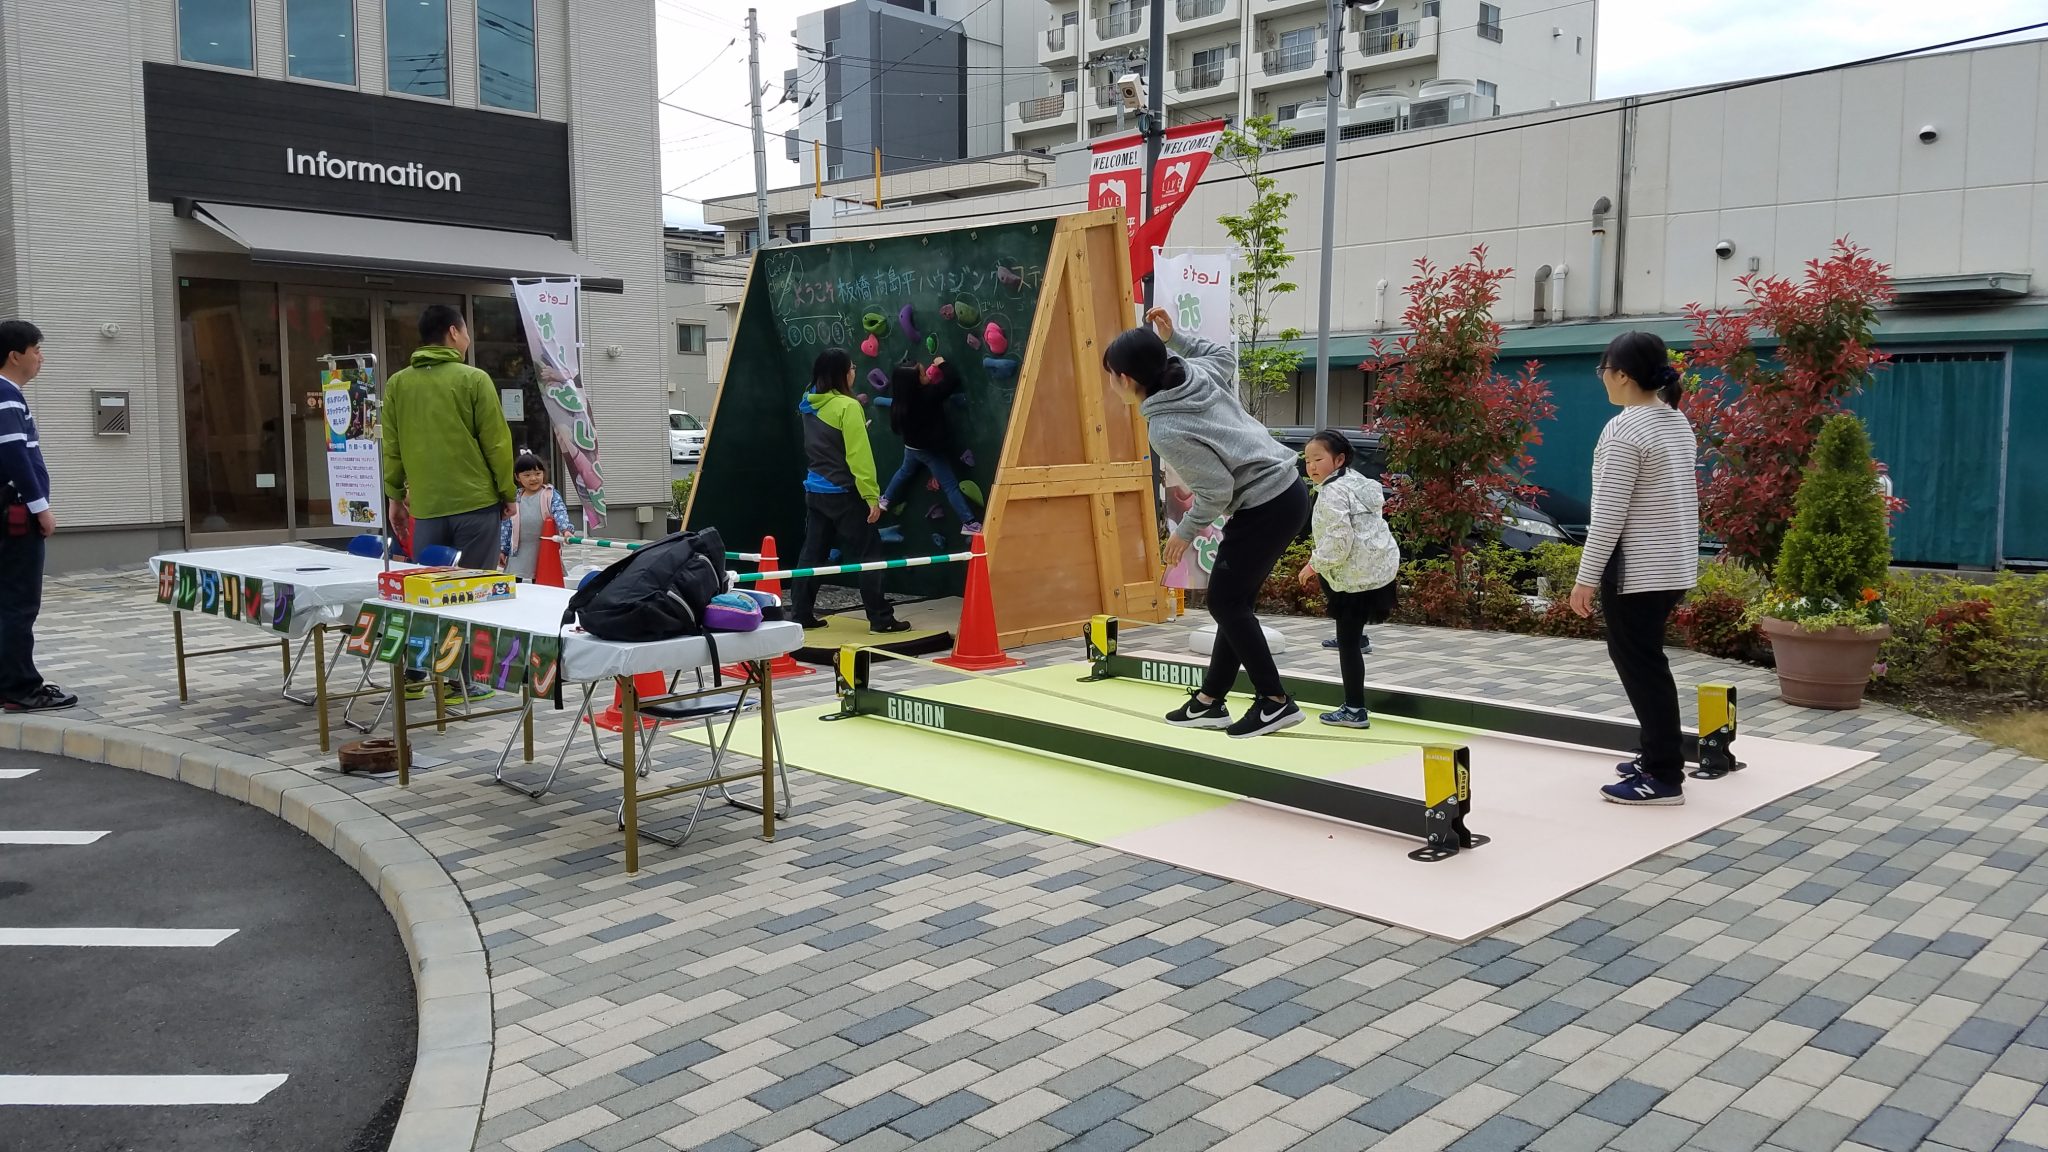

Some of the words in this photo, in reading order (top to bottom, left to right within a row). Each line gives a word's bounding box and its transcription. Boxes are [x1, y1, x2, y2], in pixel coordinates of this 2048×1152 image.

[1164, 135, 1215, 155] WELCOME!
[286, 147, 461, 192] Information
[1093, 151, 1138, 170] WELCOME!
[1162, 177, 1182, 192] LIVE
[1097, 196, 1120, 208] LIVE
[160, 562, 295, 624] ボルダリング
[349, 611, 557, 698] スラックライン
[1141, 660, 1203, 687] GIBBON
[887, 696, 945, 728] GIBBON
